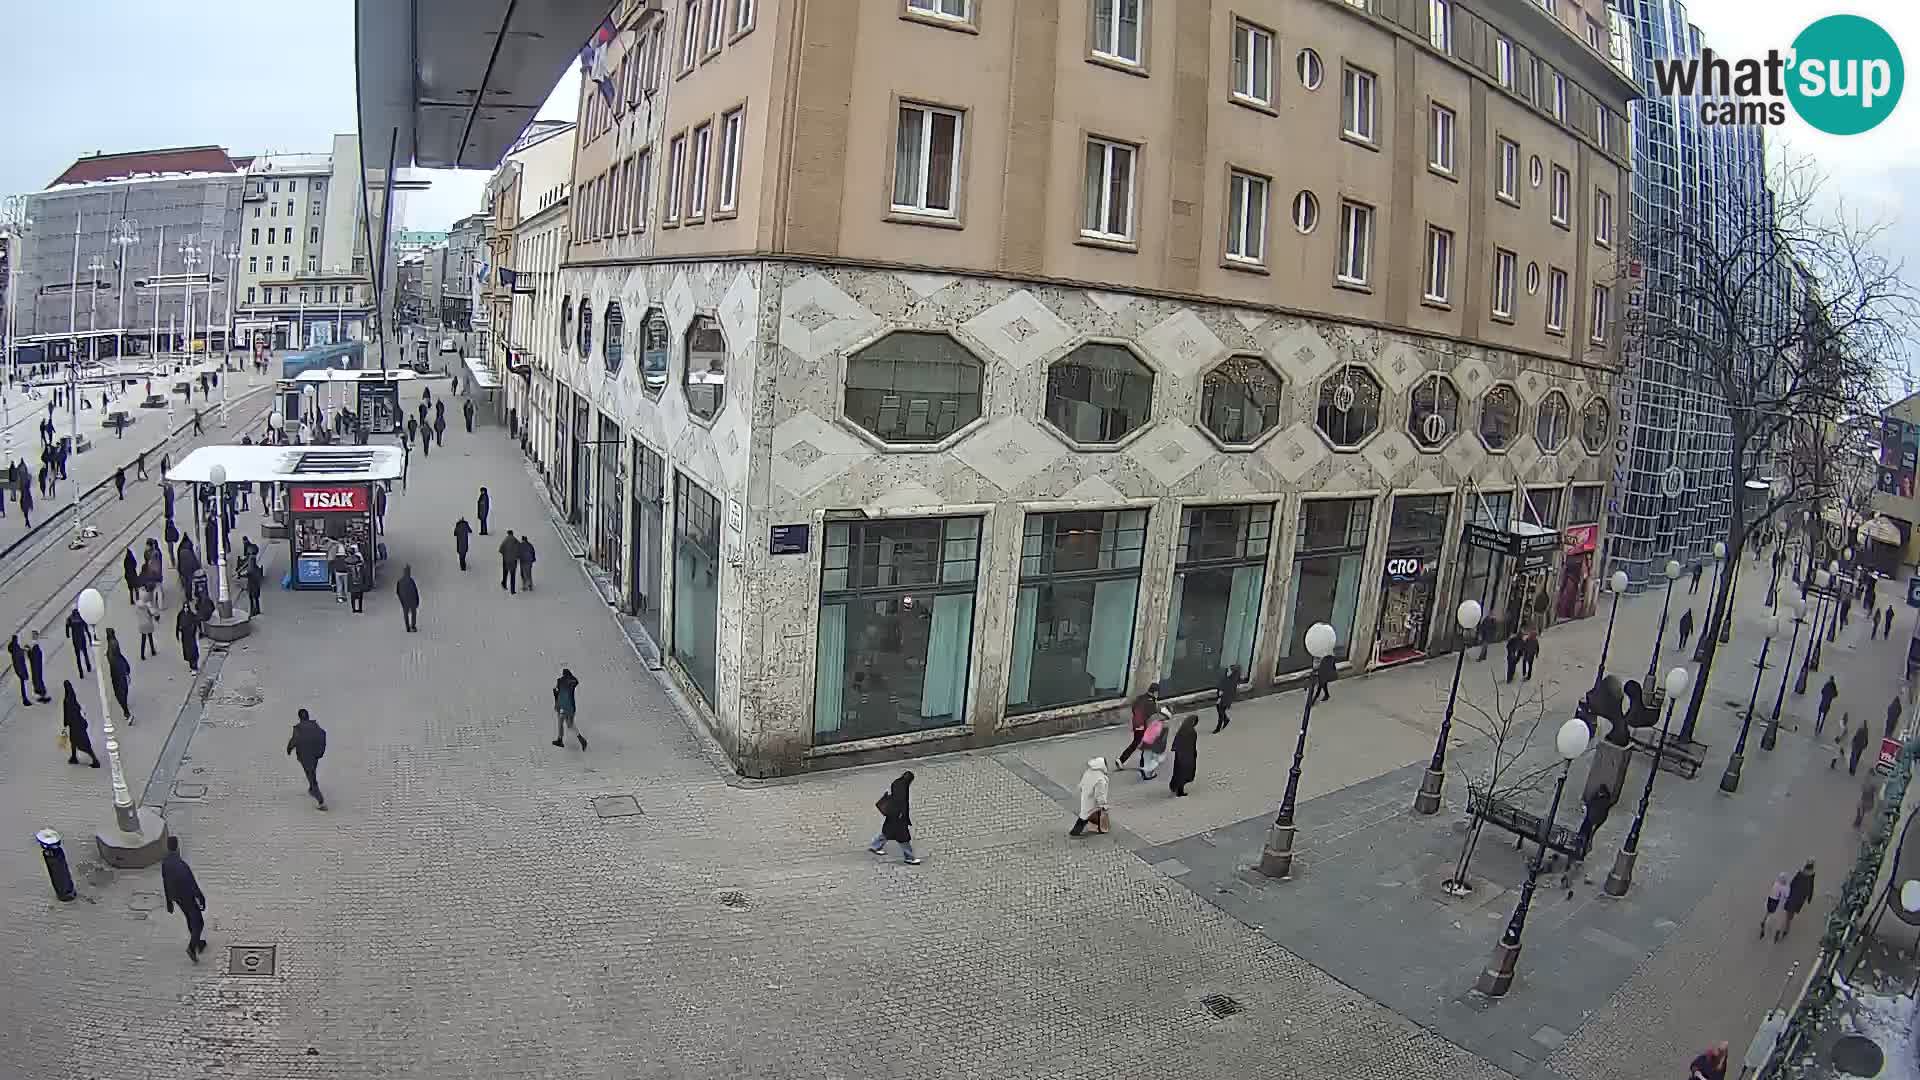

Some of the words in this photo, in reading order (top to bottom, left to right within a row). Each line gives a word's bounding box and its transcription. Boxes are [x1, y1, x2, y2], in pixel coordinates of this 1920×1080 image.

[1608, 379, 1634, 514] DUBROVNIK
[303, 492, 353, 508] TISAK
[1387, 559, 1418, 575] CRO
